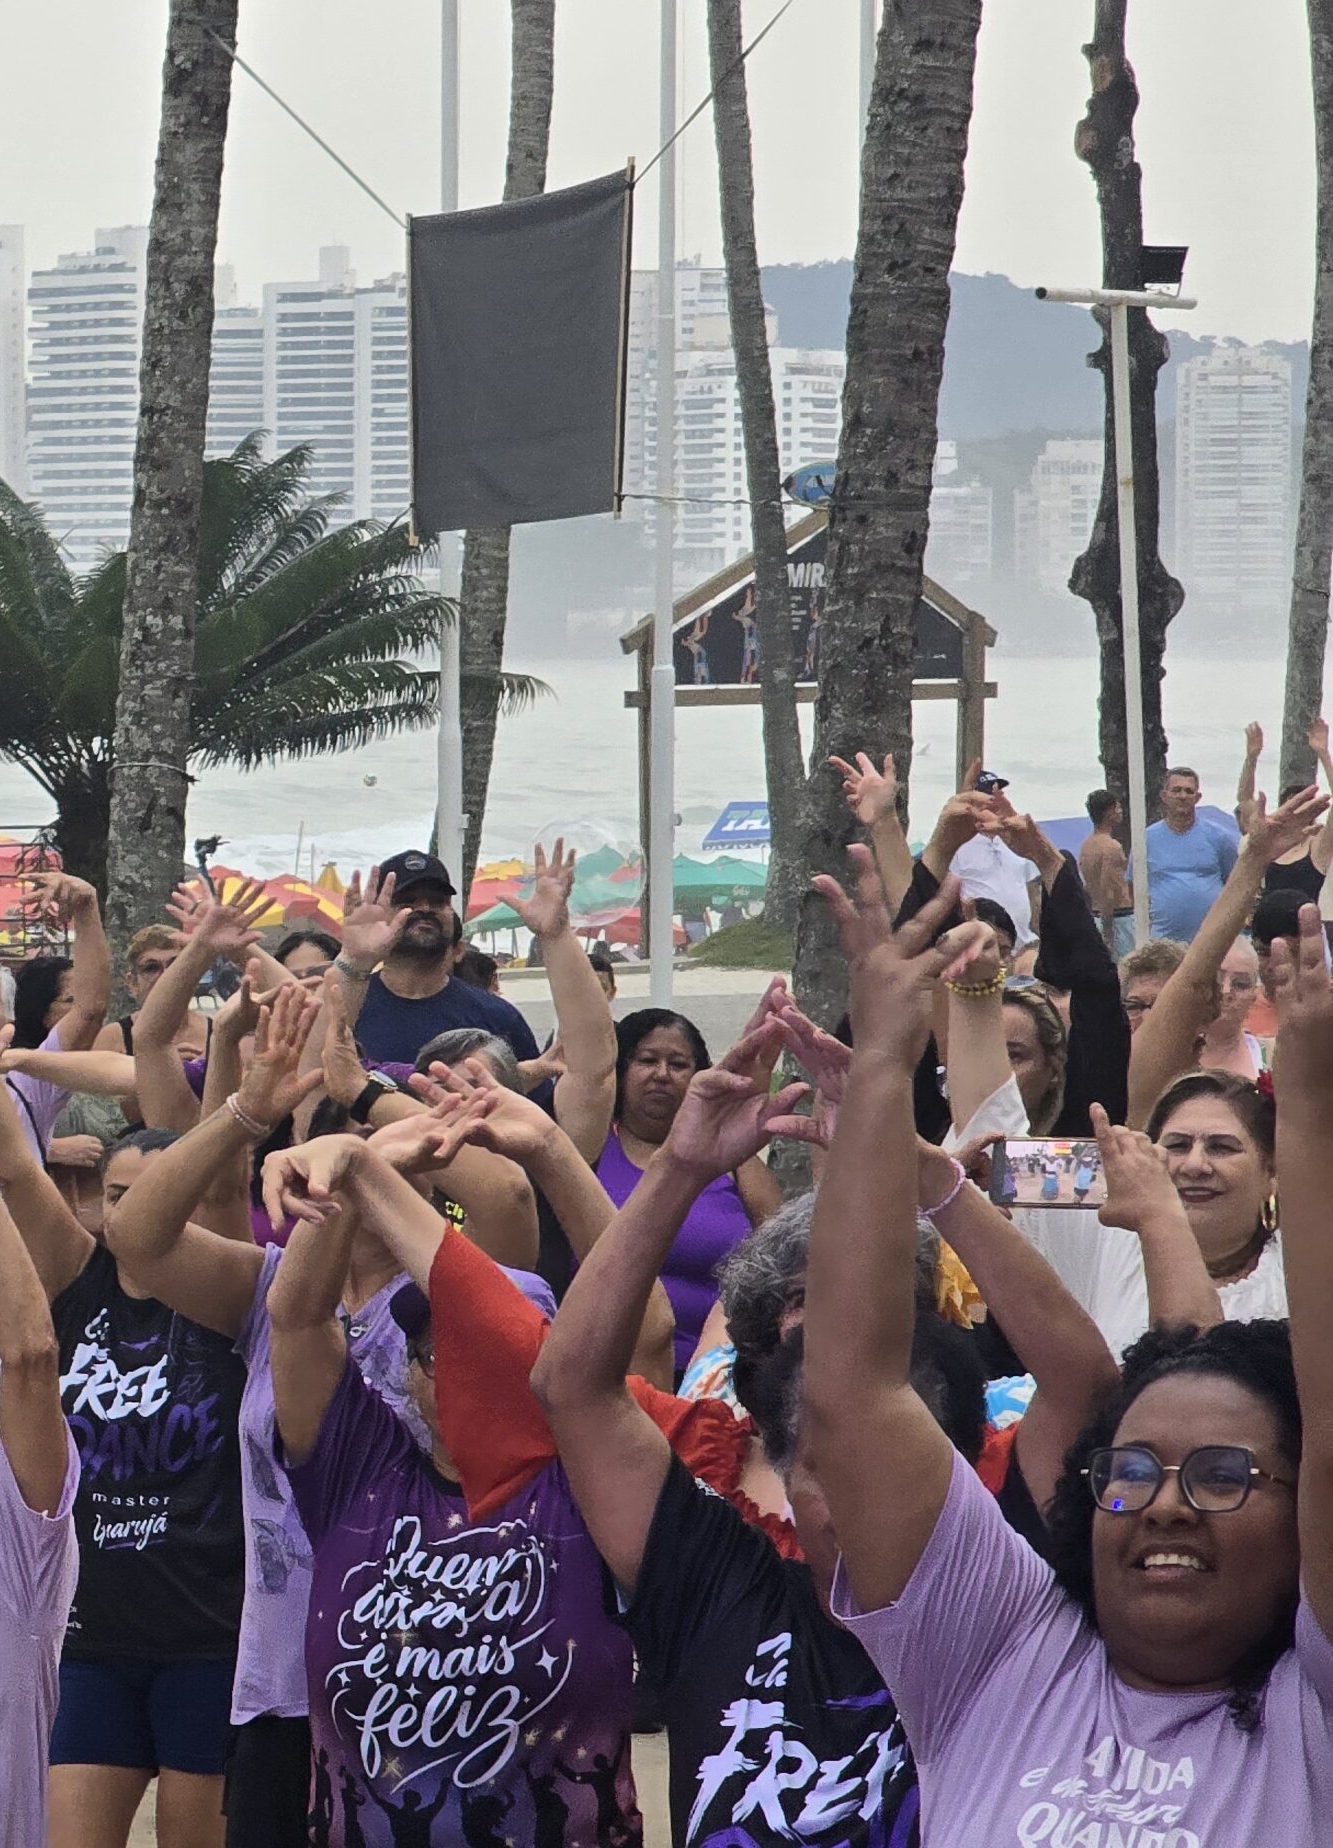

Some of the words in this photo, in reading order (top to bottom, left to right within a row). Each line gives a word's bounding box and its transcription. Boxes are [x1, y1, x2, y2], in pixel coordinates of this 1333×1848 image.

[92, 1491, 171, 1507] master
[396, 1634, 517, 1681] mais
[345, 1683, 523, 1789] feliz
